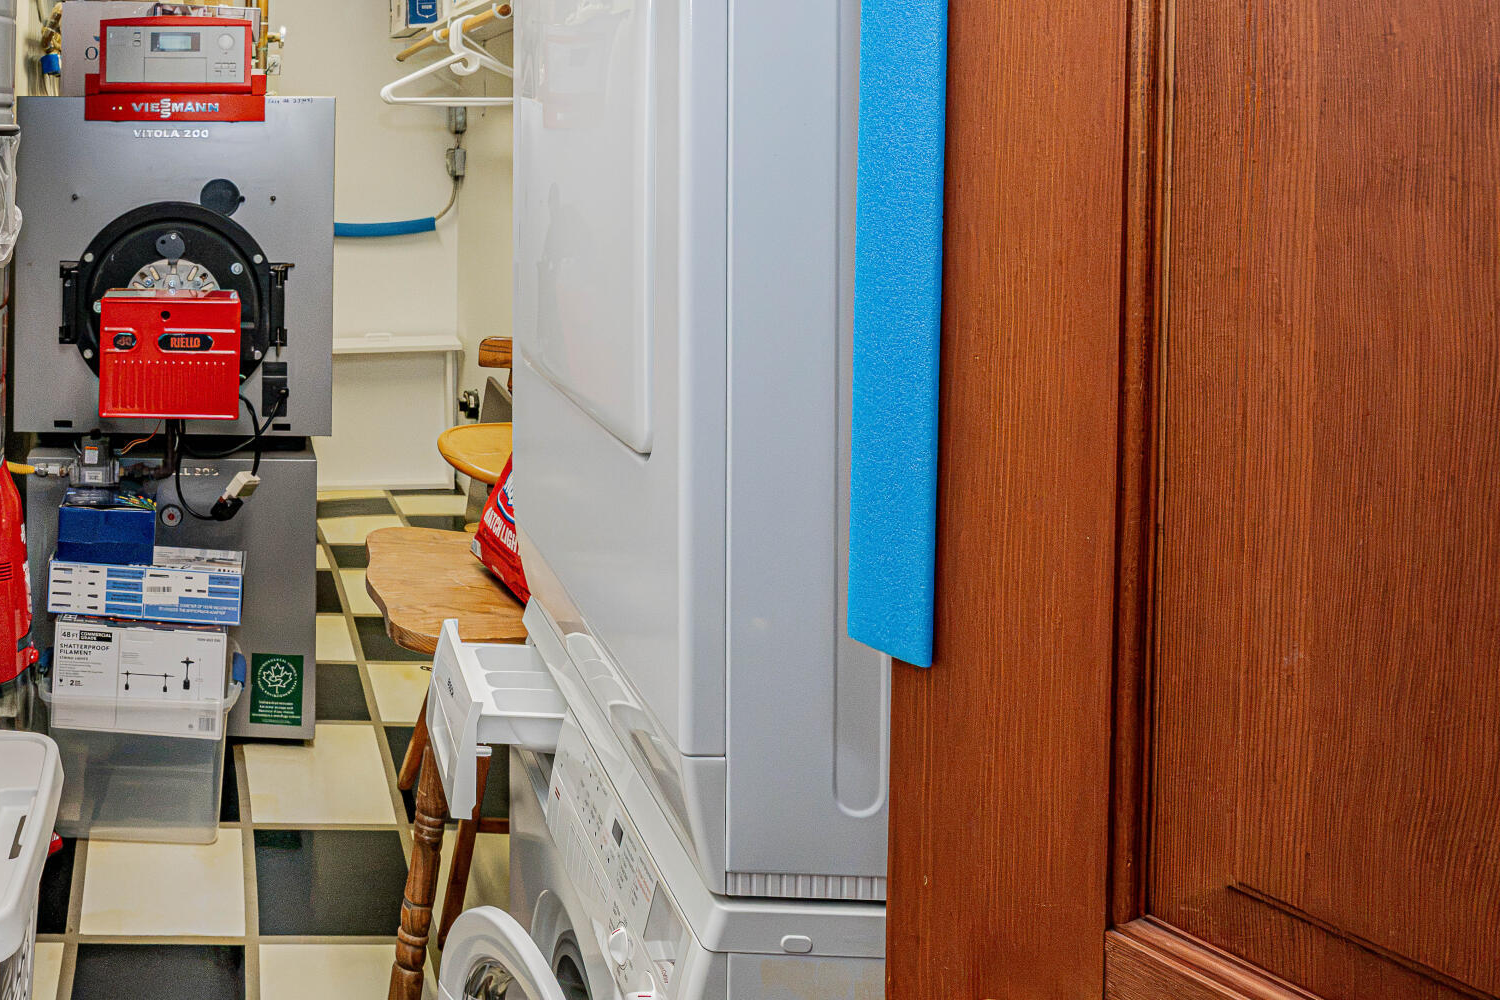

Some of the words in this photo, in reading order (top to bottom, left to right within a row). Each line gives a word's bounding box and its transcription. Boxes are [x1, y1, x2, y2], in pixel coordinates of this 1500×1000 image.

[131, 98, 219, 118] VIESSMANN
[133, 129, 180, 138] VITOLA
[183, 129, 209, 138] 200
[170, 337, 200, 348] RIELLO
[59, 643, 110, 651] SHATTERPROOF
